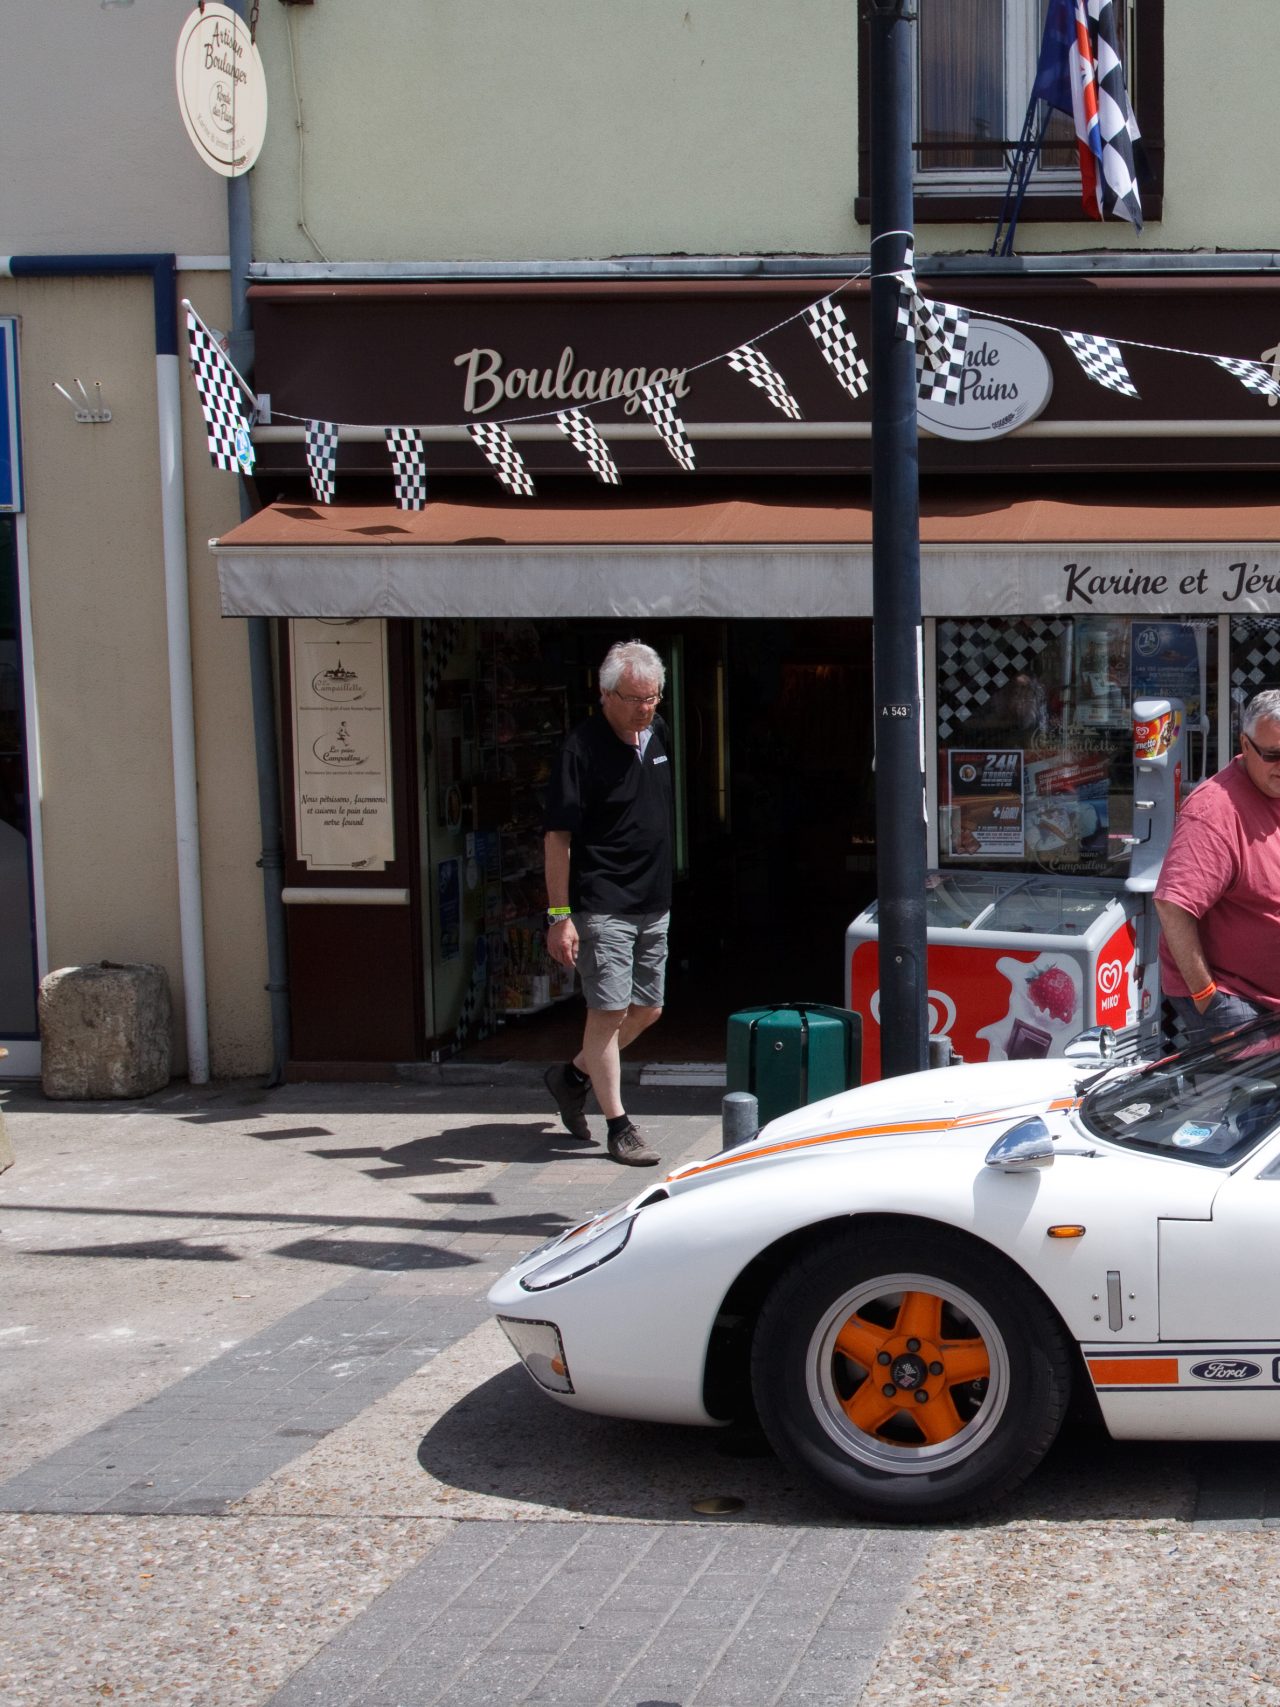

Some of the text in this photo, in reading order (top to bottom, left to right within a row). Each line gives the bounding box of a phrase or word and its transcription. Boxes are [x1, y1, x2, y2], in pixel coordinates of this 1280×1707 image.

[212, 22, 243, 58] Artisan
[204, 43, 247, 86] Boulanger
[962, 341, 1000, 367] nde
[454, 346, 691, 415] Boulanger
[959, 368, 1019, 405] Pains
[1063, 563, 1168, 604] Karine
[1179, 568, 1208, 595] et
[882, 706, 907, 716] A 543
[302, 794, 318, 805] Nous
[323, 818, 340, 826] notre
[339, 806, 346, 814] le
[347, 808, 361, 816] pain
[1101, 994, 1119, 1011] MIKO
[1203, 1361, 1247, 1379] Ford
